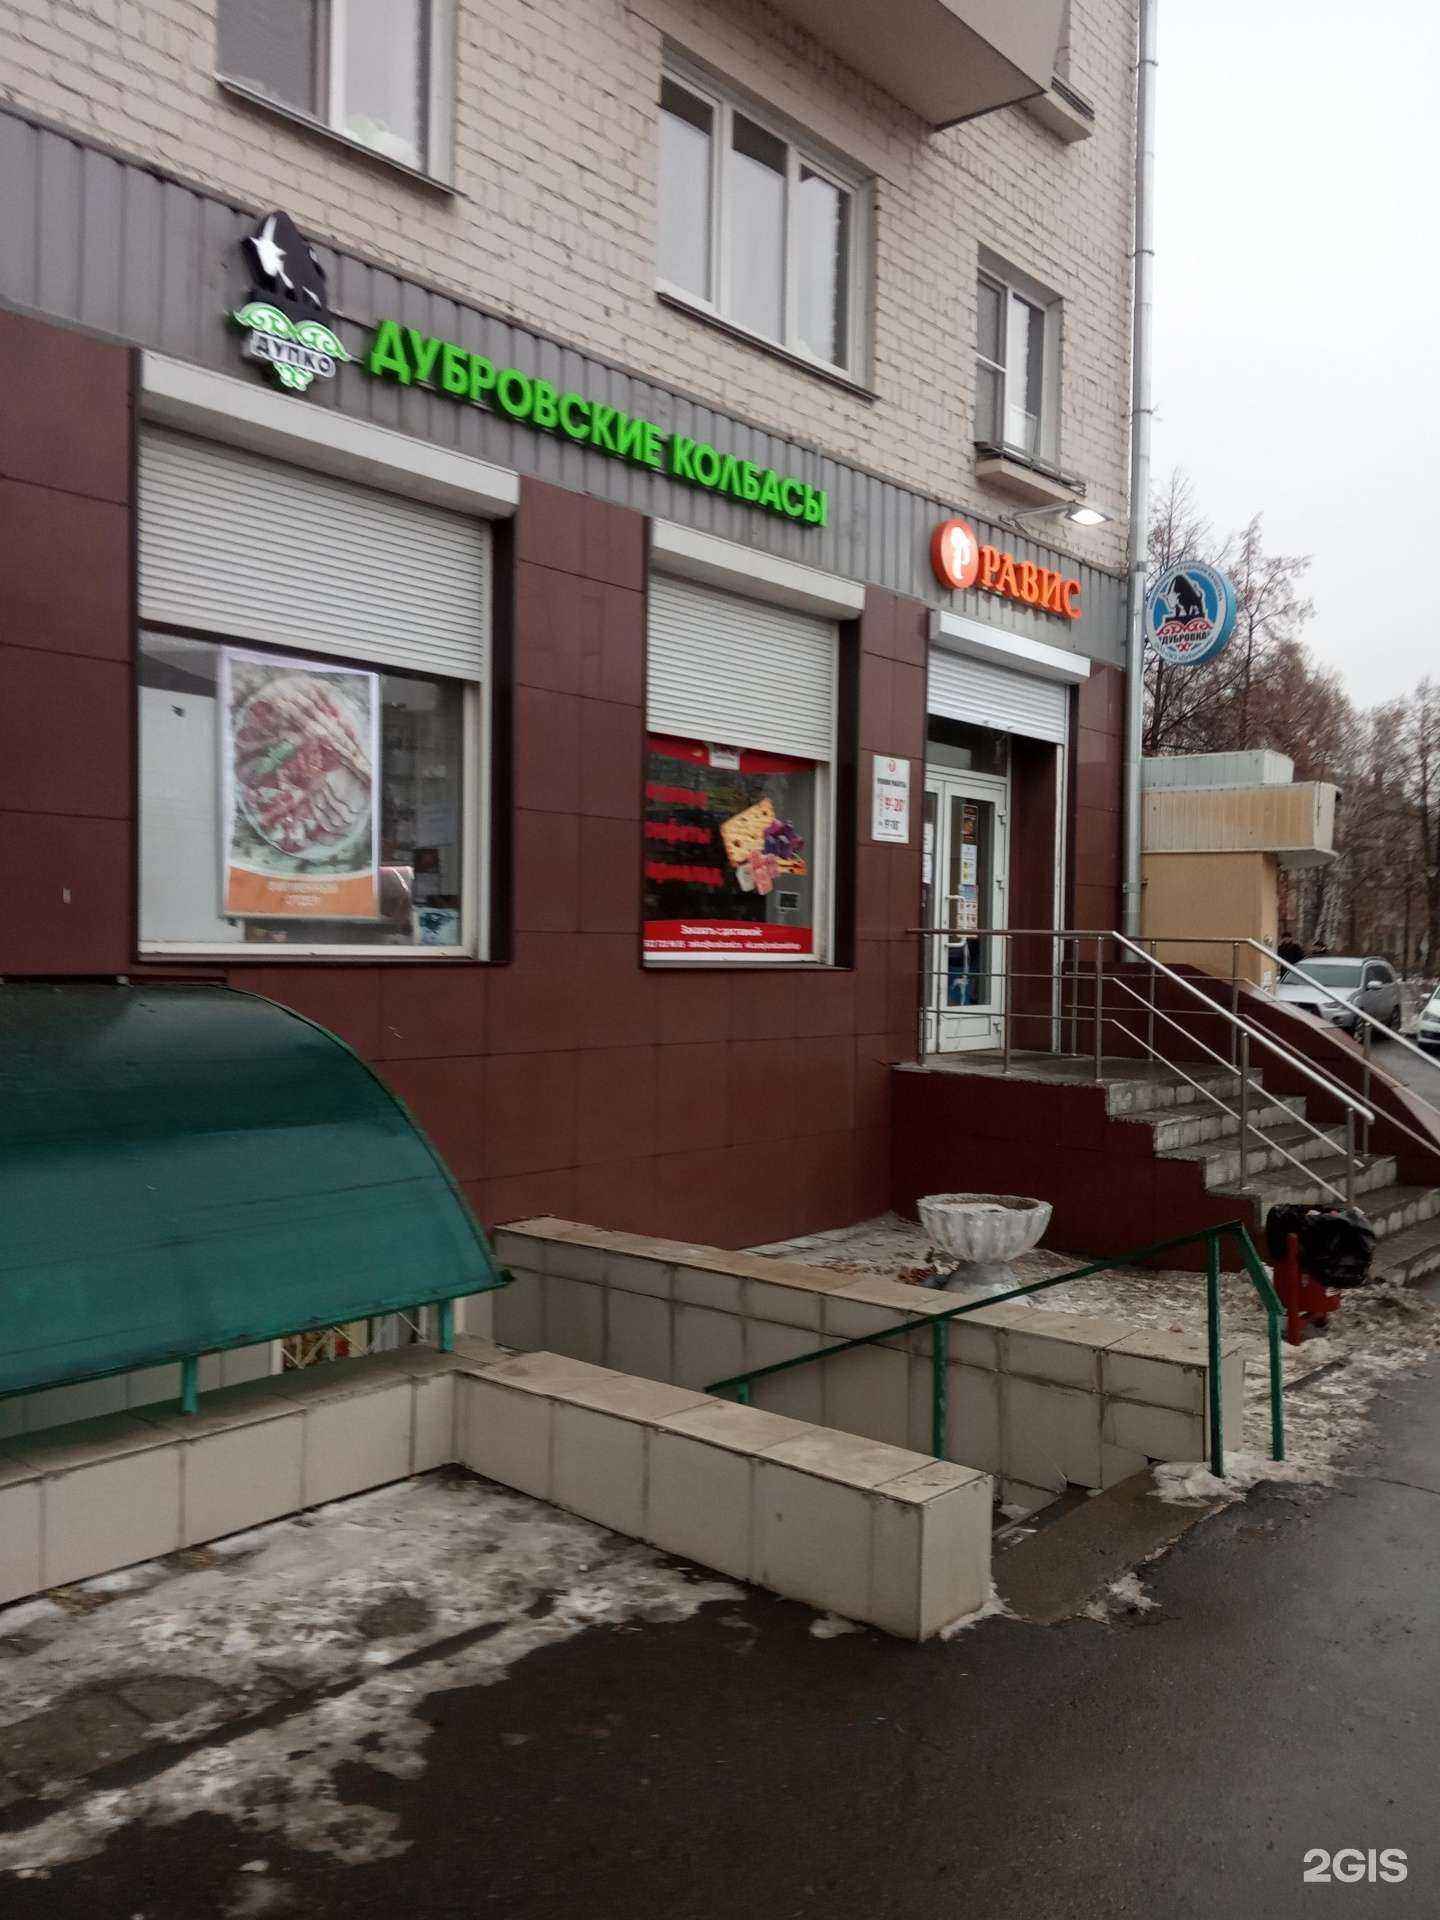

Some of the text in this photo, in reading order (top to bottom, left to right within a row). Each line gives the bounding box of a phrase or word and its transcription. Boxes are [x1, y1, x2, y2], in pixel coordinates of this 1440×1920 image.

[370, 320, 829, 528] ДУБРОВСКИЕ КОЛБАСЫ
[978, 544, 1082, 619] РАВИС
